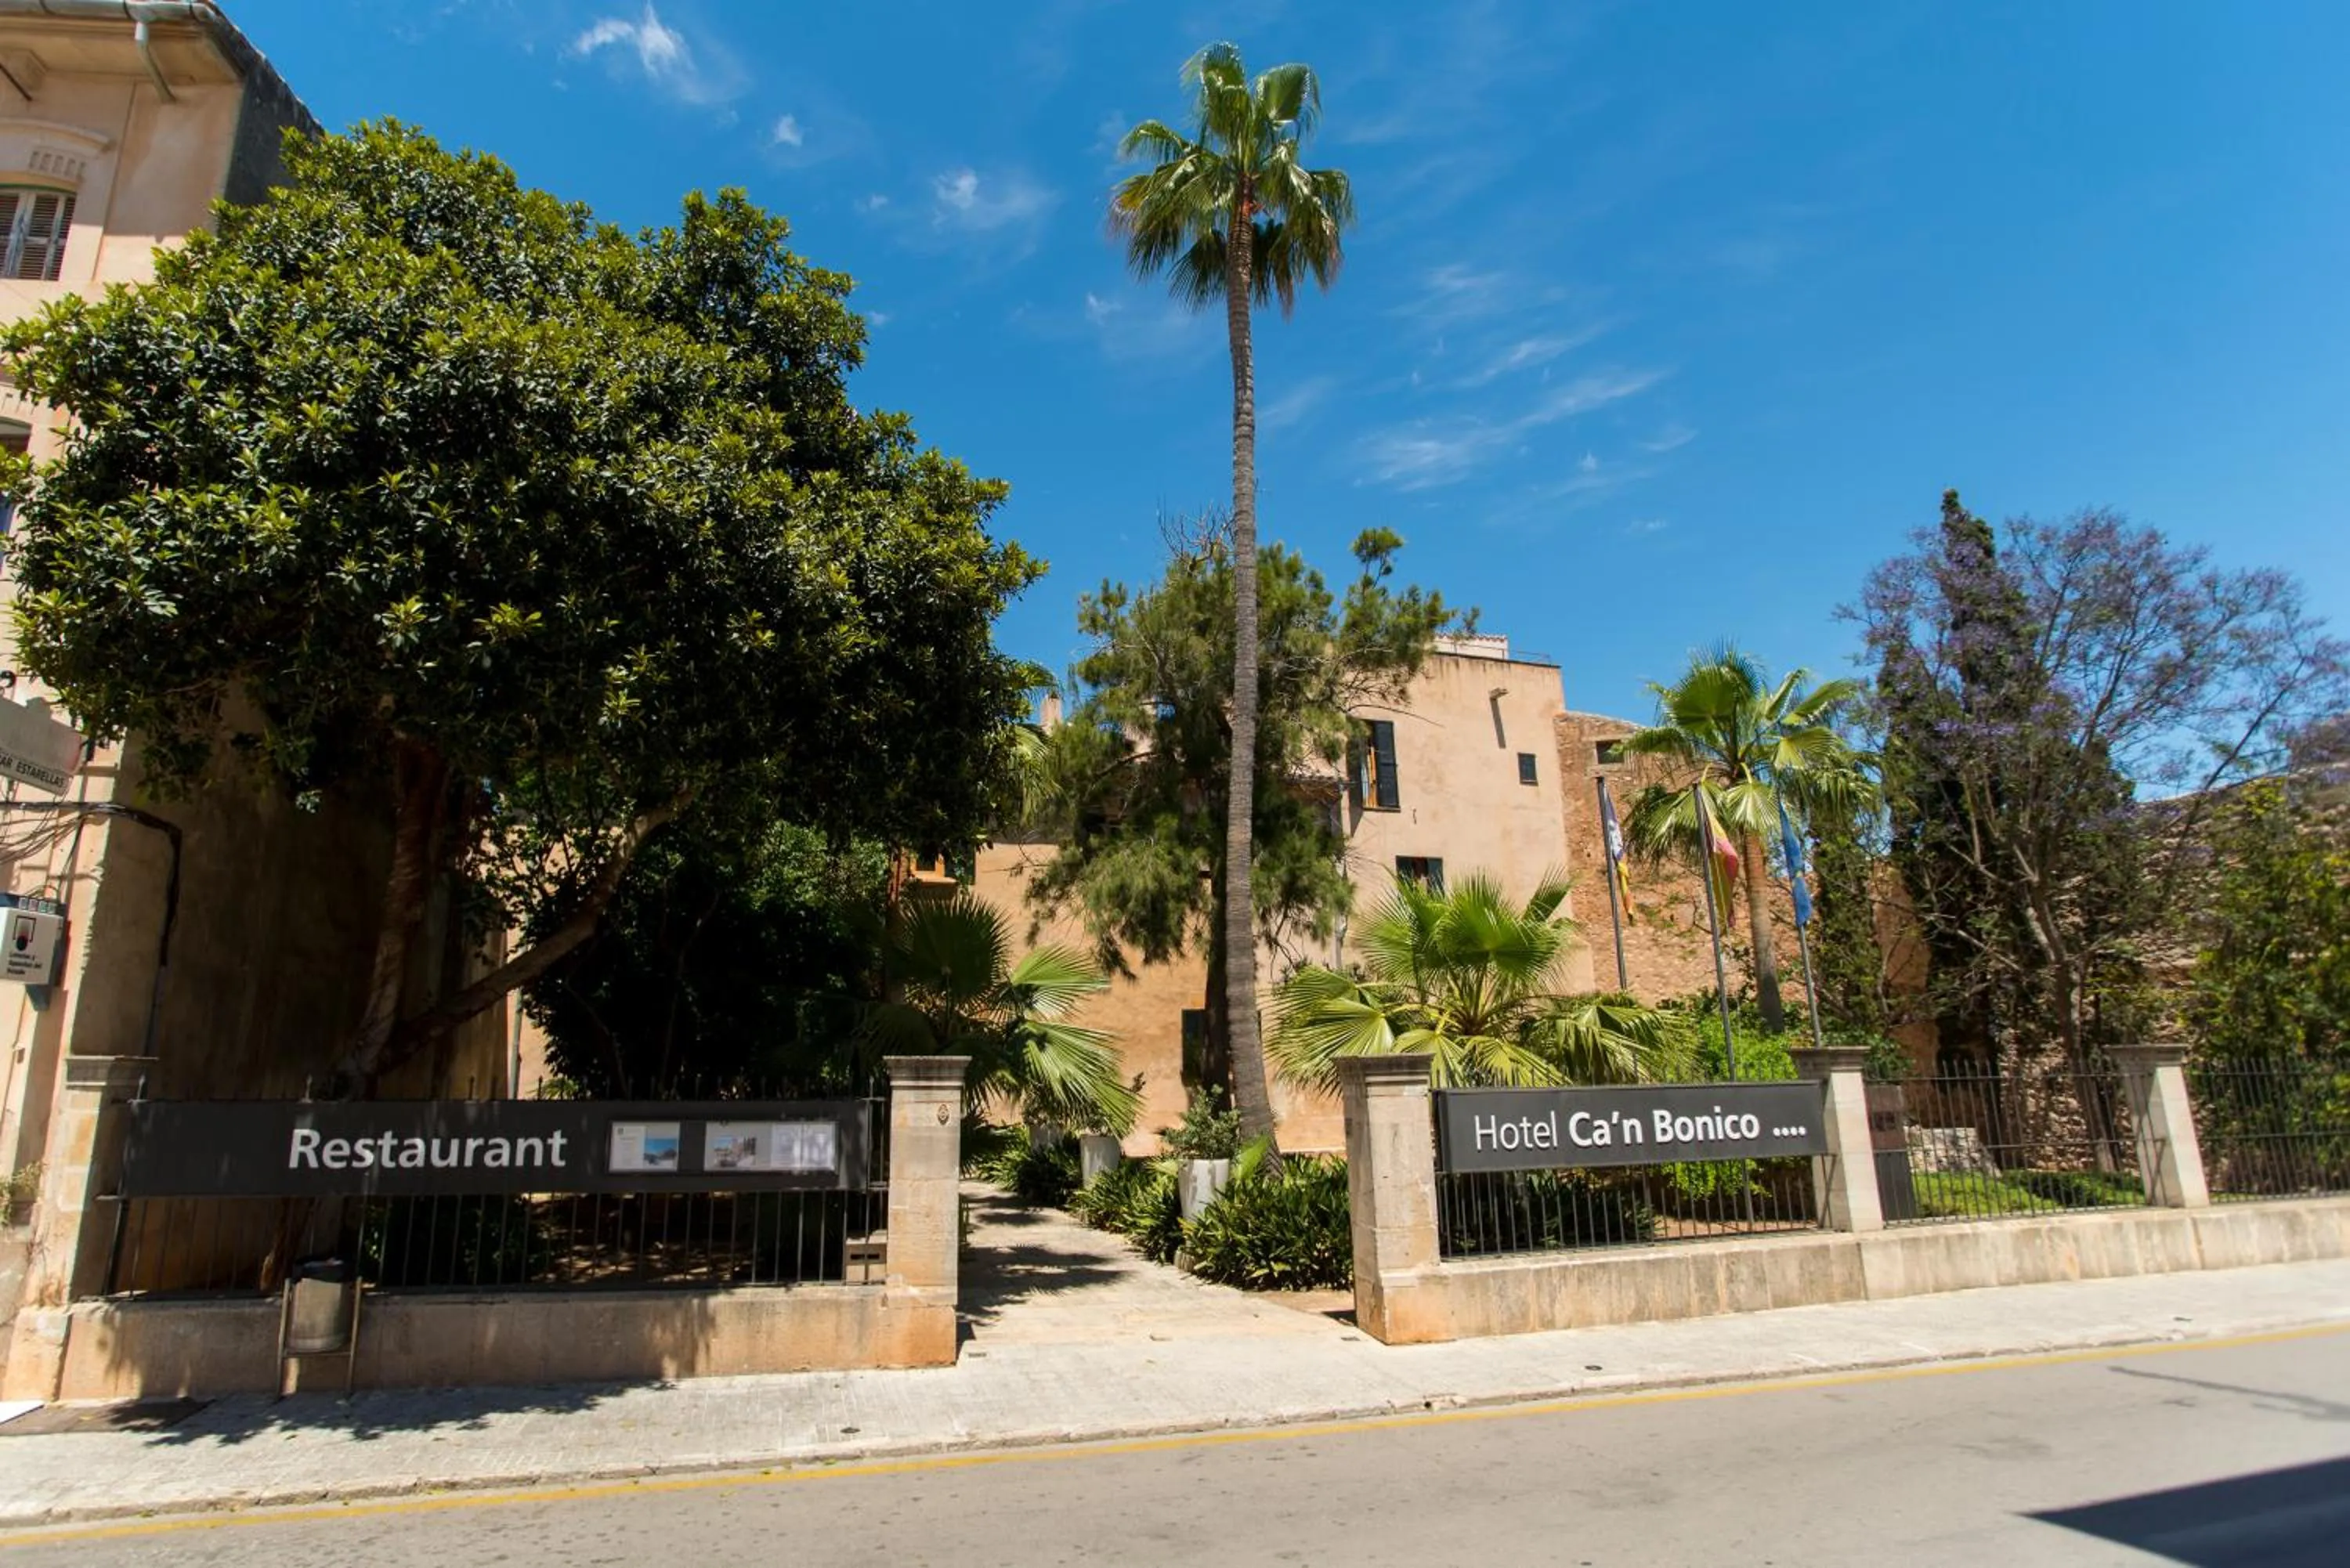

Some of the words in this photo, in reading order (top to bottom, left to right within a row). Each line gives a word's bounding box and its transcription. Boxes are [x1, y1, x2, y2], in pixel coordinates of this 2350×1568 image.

[0, 755, 13, 767] AR
[1474, 1110, 1558, 1150] Hotel
[1569, 1111, 1643, 1147] Ca'n
[1652, 1105, 1760, 1143] Bonico
[288, 1129, 568, 1169] Restaurant
